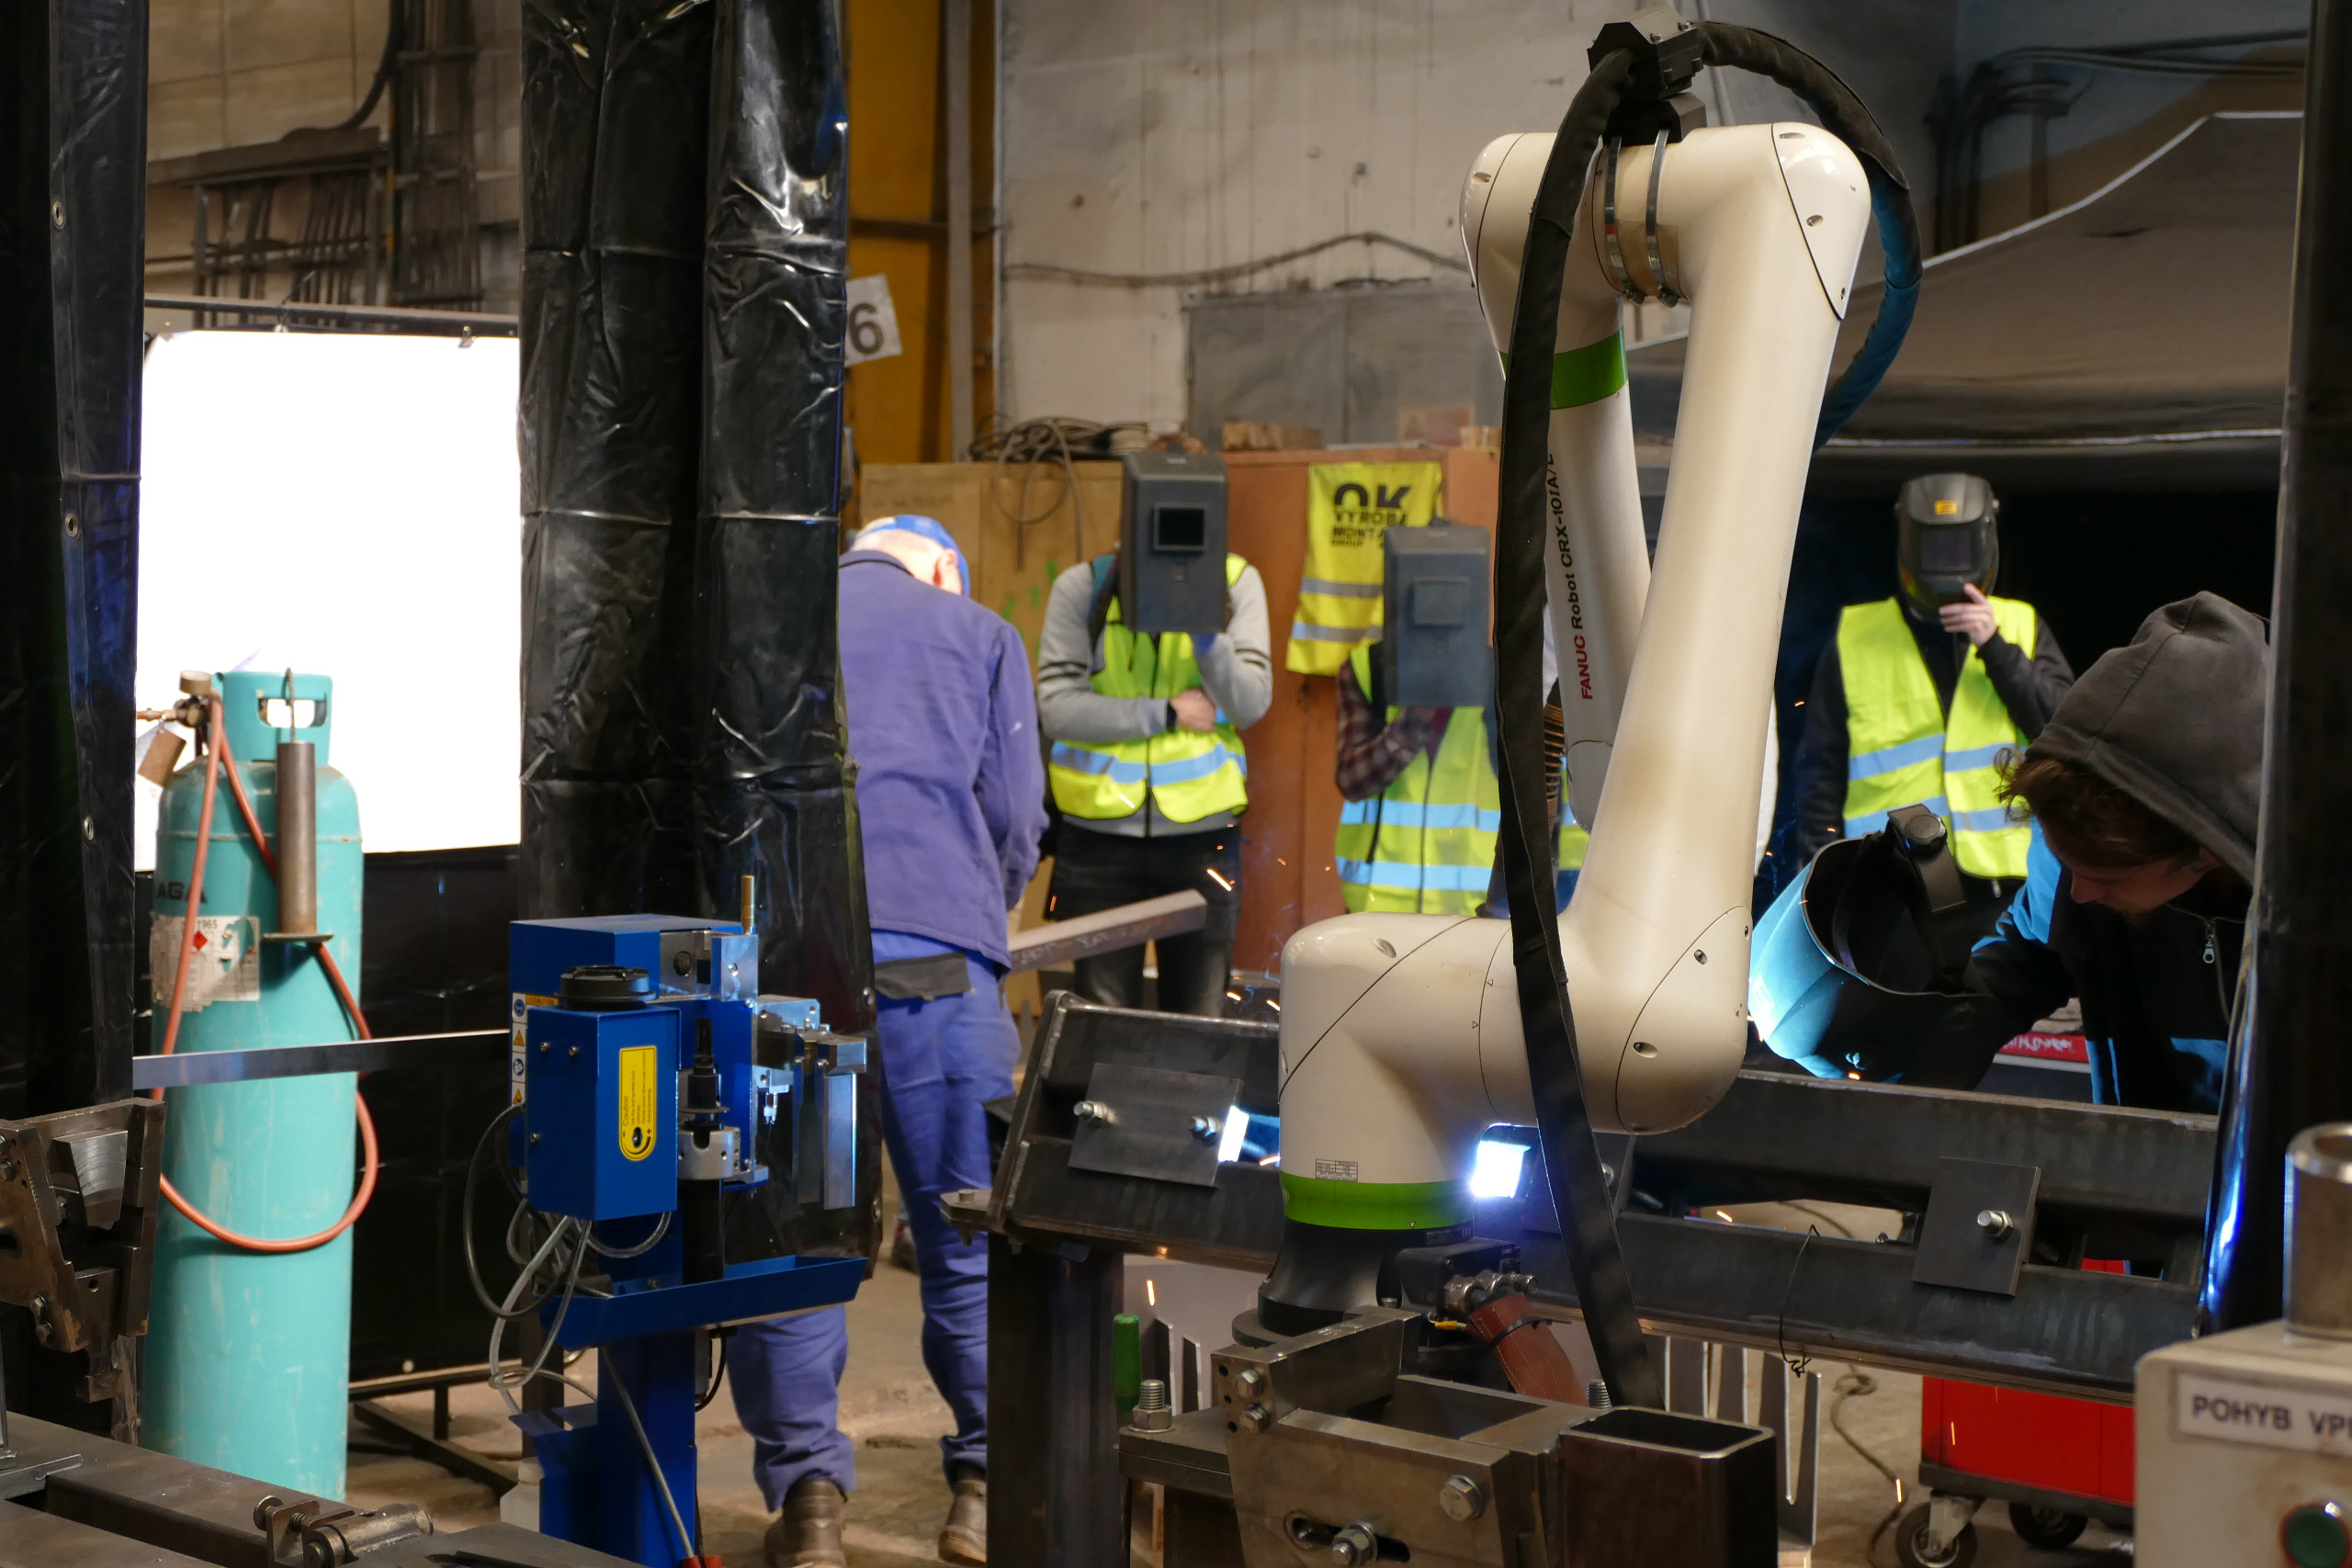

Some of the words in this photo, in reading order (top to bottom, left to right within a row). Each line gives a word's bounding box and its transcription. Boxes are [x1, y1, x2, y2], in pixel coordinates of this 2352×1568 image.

[1335, 483, 1411, 509] OK
[1567, 573, 1584, 630] Robot
[1574, 635, 1593, 700] FANUC
[2192, 1395, 2292, 1431] POHYB
